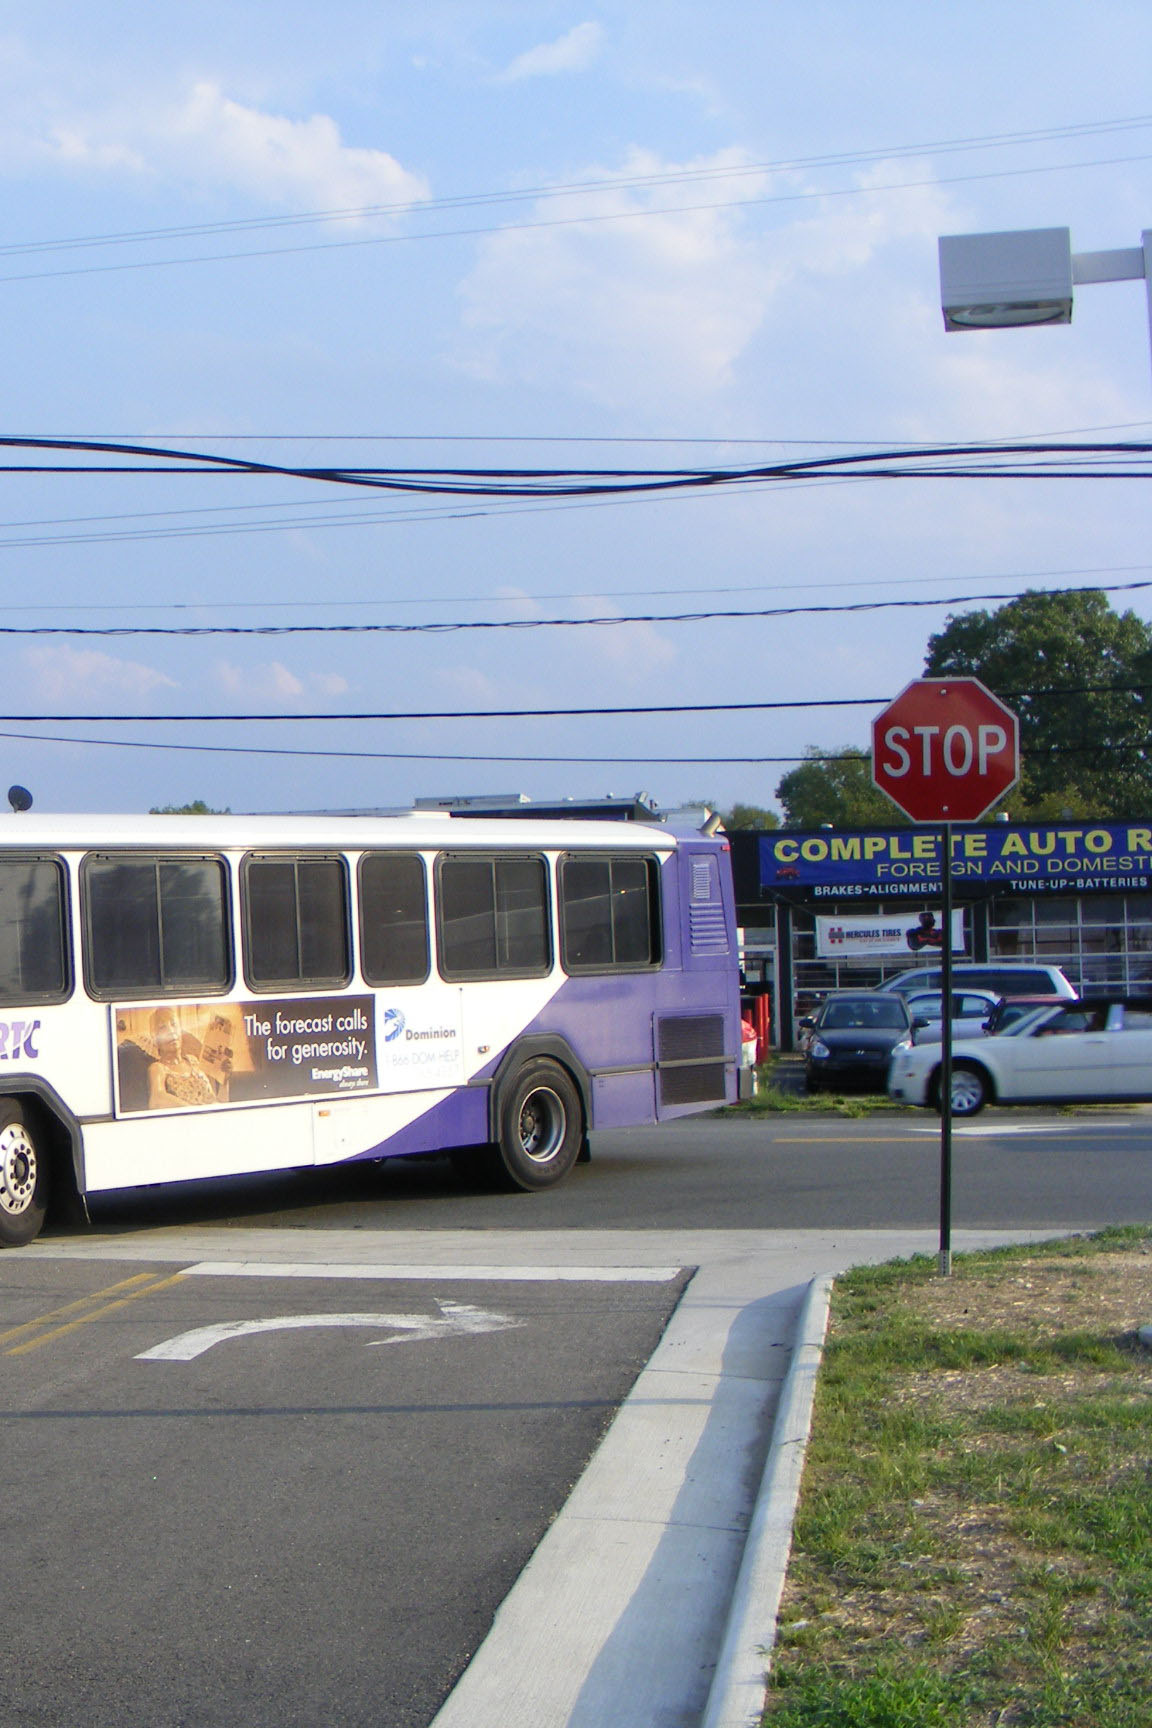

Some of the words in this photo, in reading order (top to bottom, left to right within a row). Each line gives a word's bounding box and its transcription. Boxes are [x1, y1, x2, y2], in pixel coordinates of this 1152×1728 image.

[883, 724, 1007, 777] STOP
[773, 833, 987, 862] COMPLETE
[1000, 829, 1112, 856] AUTO
[876, 861, 982, 878] FOREGN
[990, 859, 1039, 874] AND
[846, 929, 880, 939] HERCULES
[882, 927, 902, 937] TIRES
[244, 1013, 271, 1036] The
[276, 1011, 333, 1035] forecast
[336, 1008, 368, 1031] calls
[405, 1026, 456, 1041] Dominion
[267, 1037, 288, 1060] for
[292, 1036, 368, 1064] generosity.
[311, 1065, 368, 1081] EnergyShare
